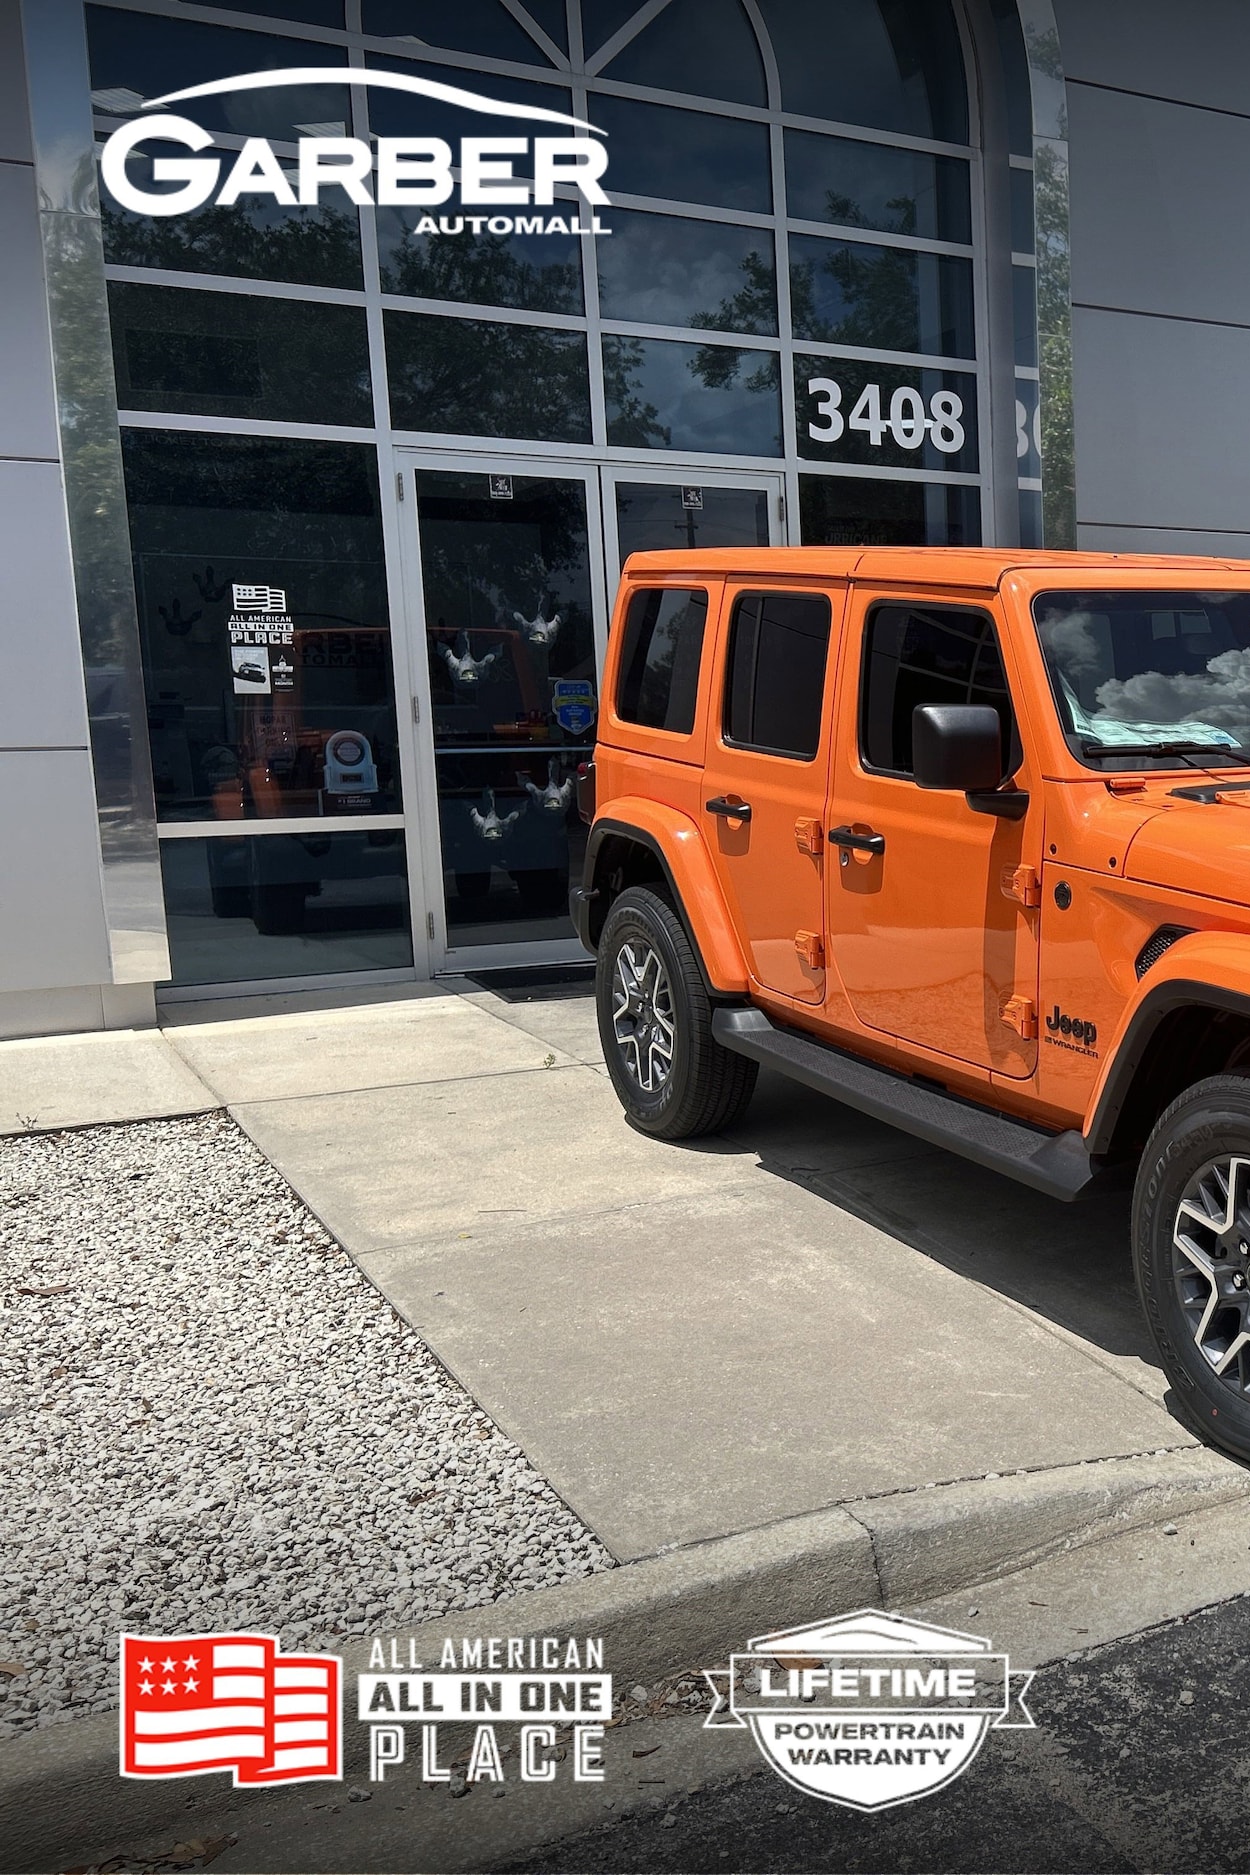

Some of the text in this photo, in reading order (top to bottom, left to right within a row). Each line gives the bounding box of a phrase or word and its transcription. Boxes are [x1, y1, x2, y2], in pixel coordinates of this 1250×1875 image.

[808, 377, 965, 453] 3408
[230, 614, 292, 623] ALL AMERICAN
[254, 623, 266, 631] IN
[231, 631, 293, 645] PLACE
[1046, 1004, 1097, 1047] Jeep
[1052, 1038, 1099, 1059] WRANGLER
